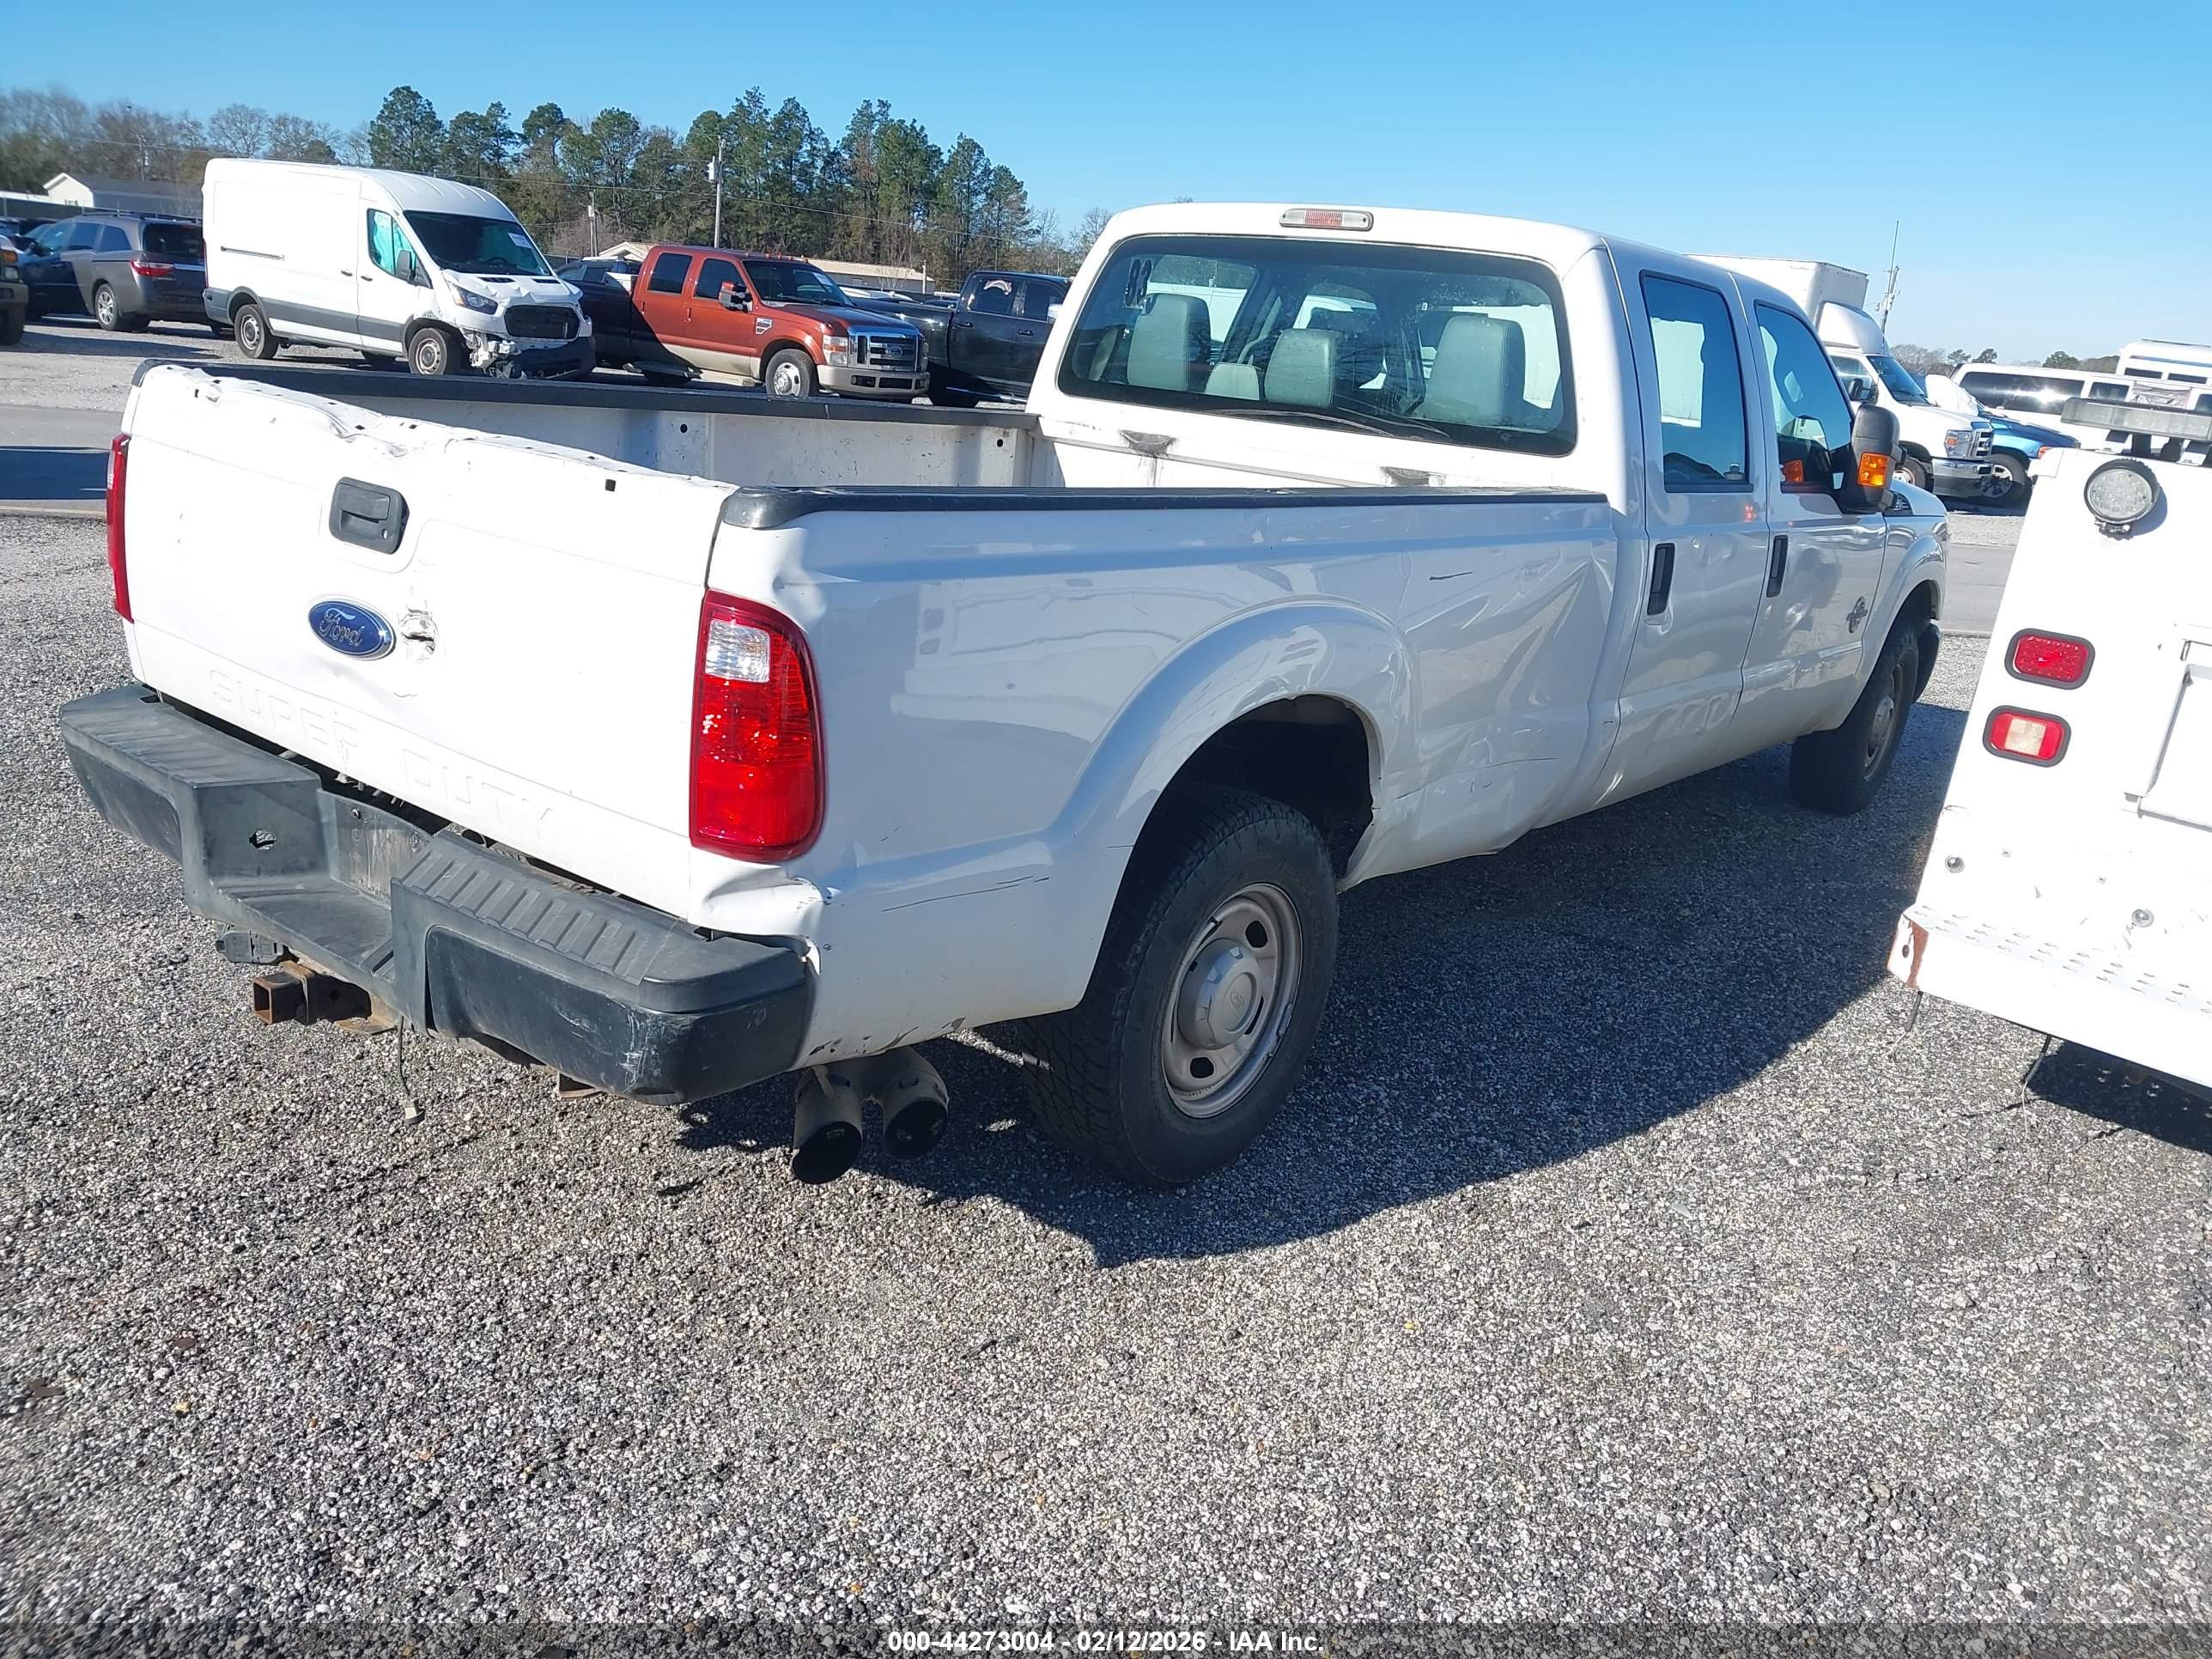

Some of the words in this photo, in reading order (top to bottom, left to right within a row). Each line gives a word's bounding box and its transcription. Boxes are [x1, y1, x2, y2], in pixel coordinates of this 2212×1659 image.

[318, 607, 365, 647] Ford
[209, 668, 361, 761] SUPER
[403, 748, 556, 841] DUTY
